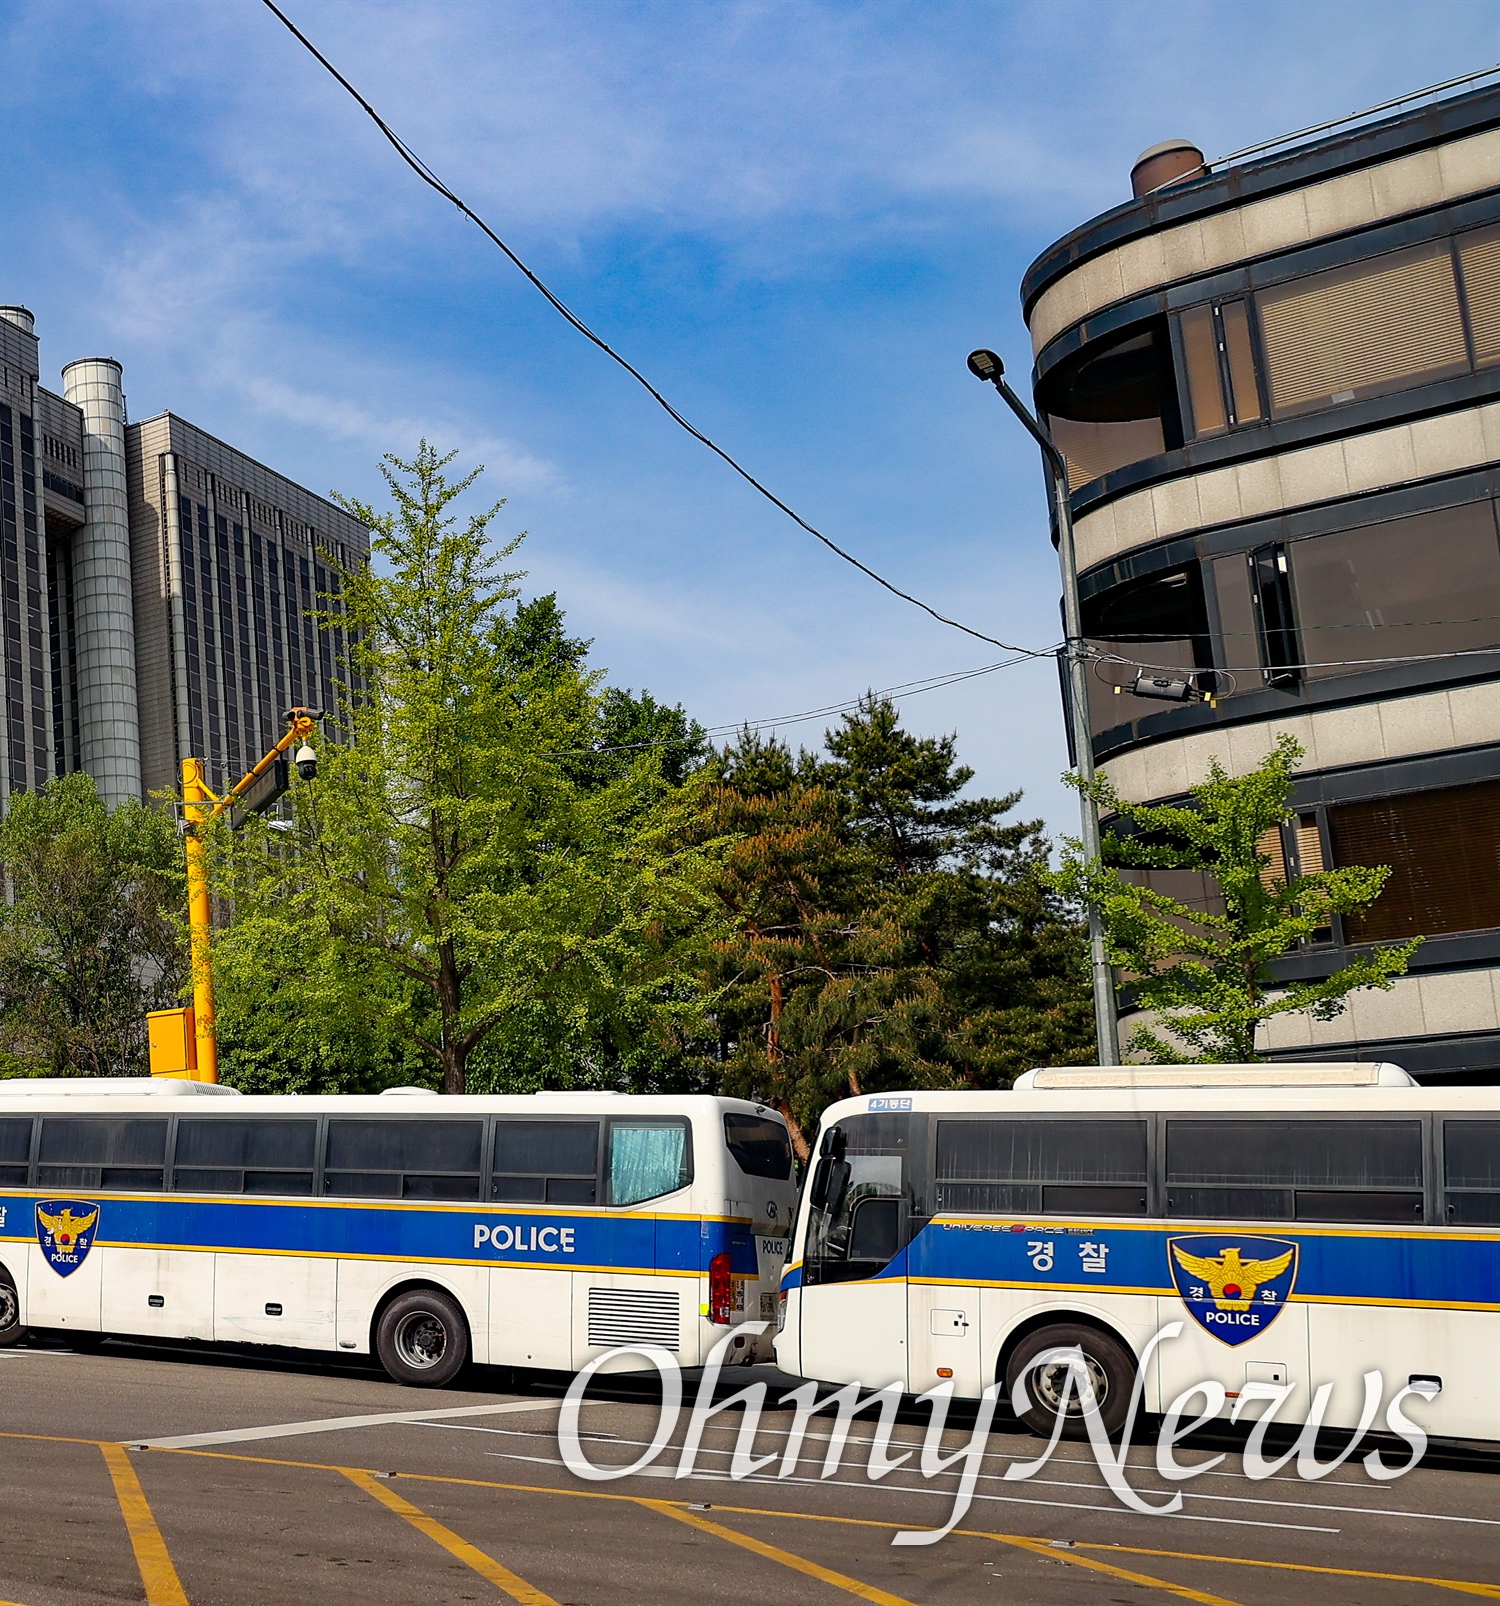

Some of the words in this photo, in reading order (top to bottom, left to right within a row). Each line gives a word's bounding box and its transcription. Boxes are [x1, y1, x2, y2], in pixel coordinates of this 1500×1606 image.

[870, 1099, 911, 1109] 4기동단
[474, 1224, 575, 1253] POLICE
[762, 1240, 783, 1255] POLICE
[51, 1253, 78, 1264] POLICE
[1205, 1311, 1260, 1326] POLICE
